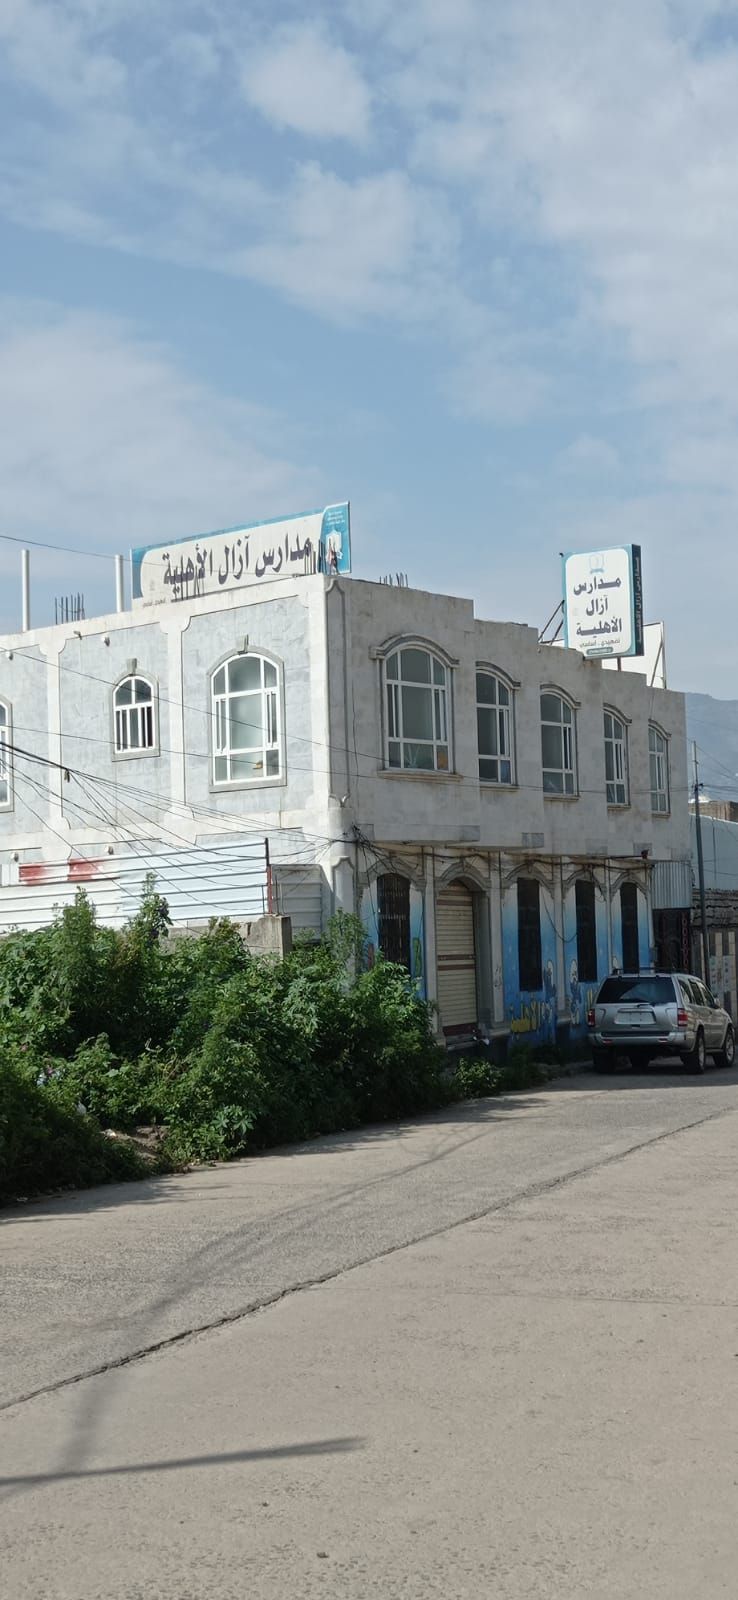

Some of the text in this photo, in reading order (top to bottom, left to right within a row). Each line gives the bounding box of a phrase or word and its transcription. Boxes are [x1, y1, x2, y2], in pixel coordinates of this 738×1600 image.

[163, 532, 312, 597] مدارس آزال الأهلية
[573, 576, 622, 596] مدارس
[585, 595, 609, 616] آزال
[576, 616, 623, 639] الأهلية
